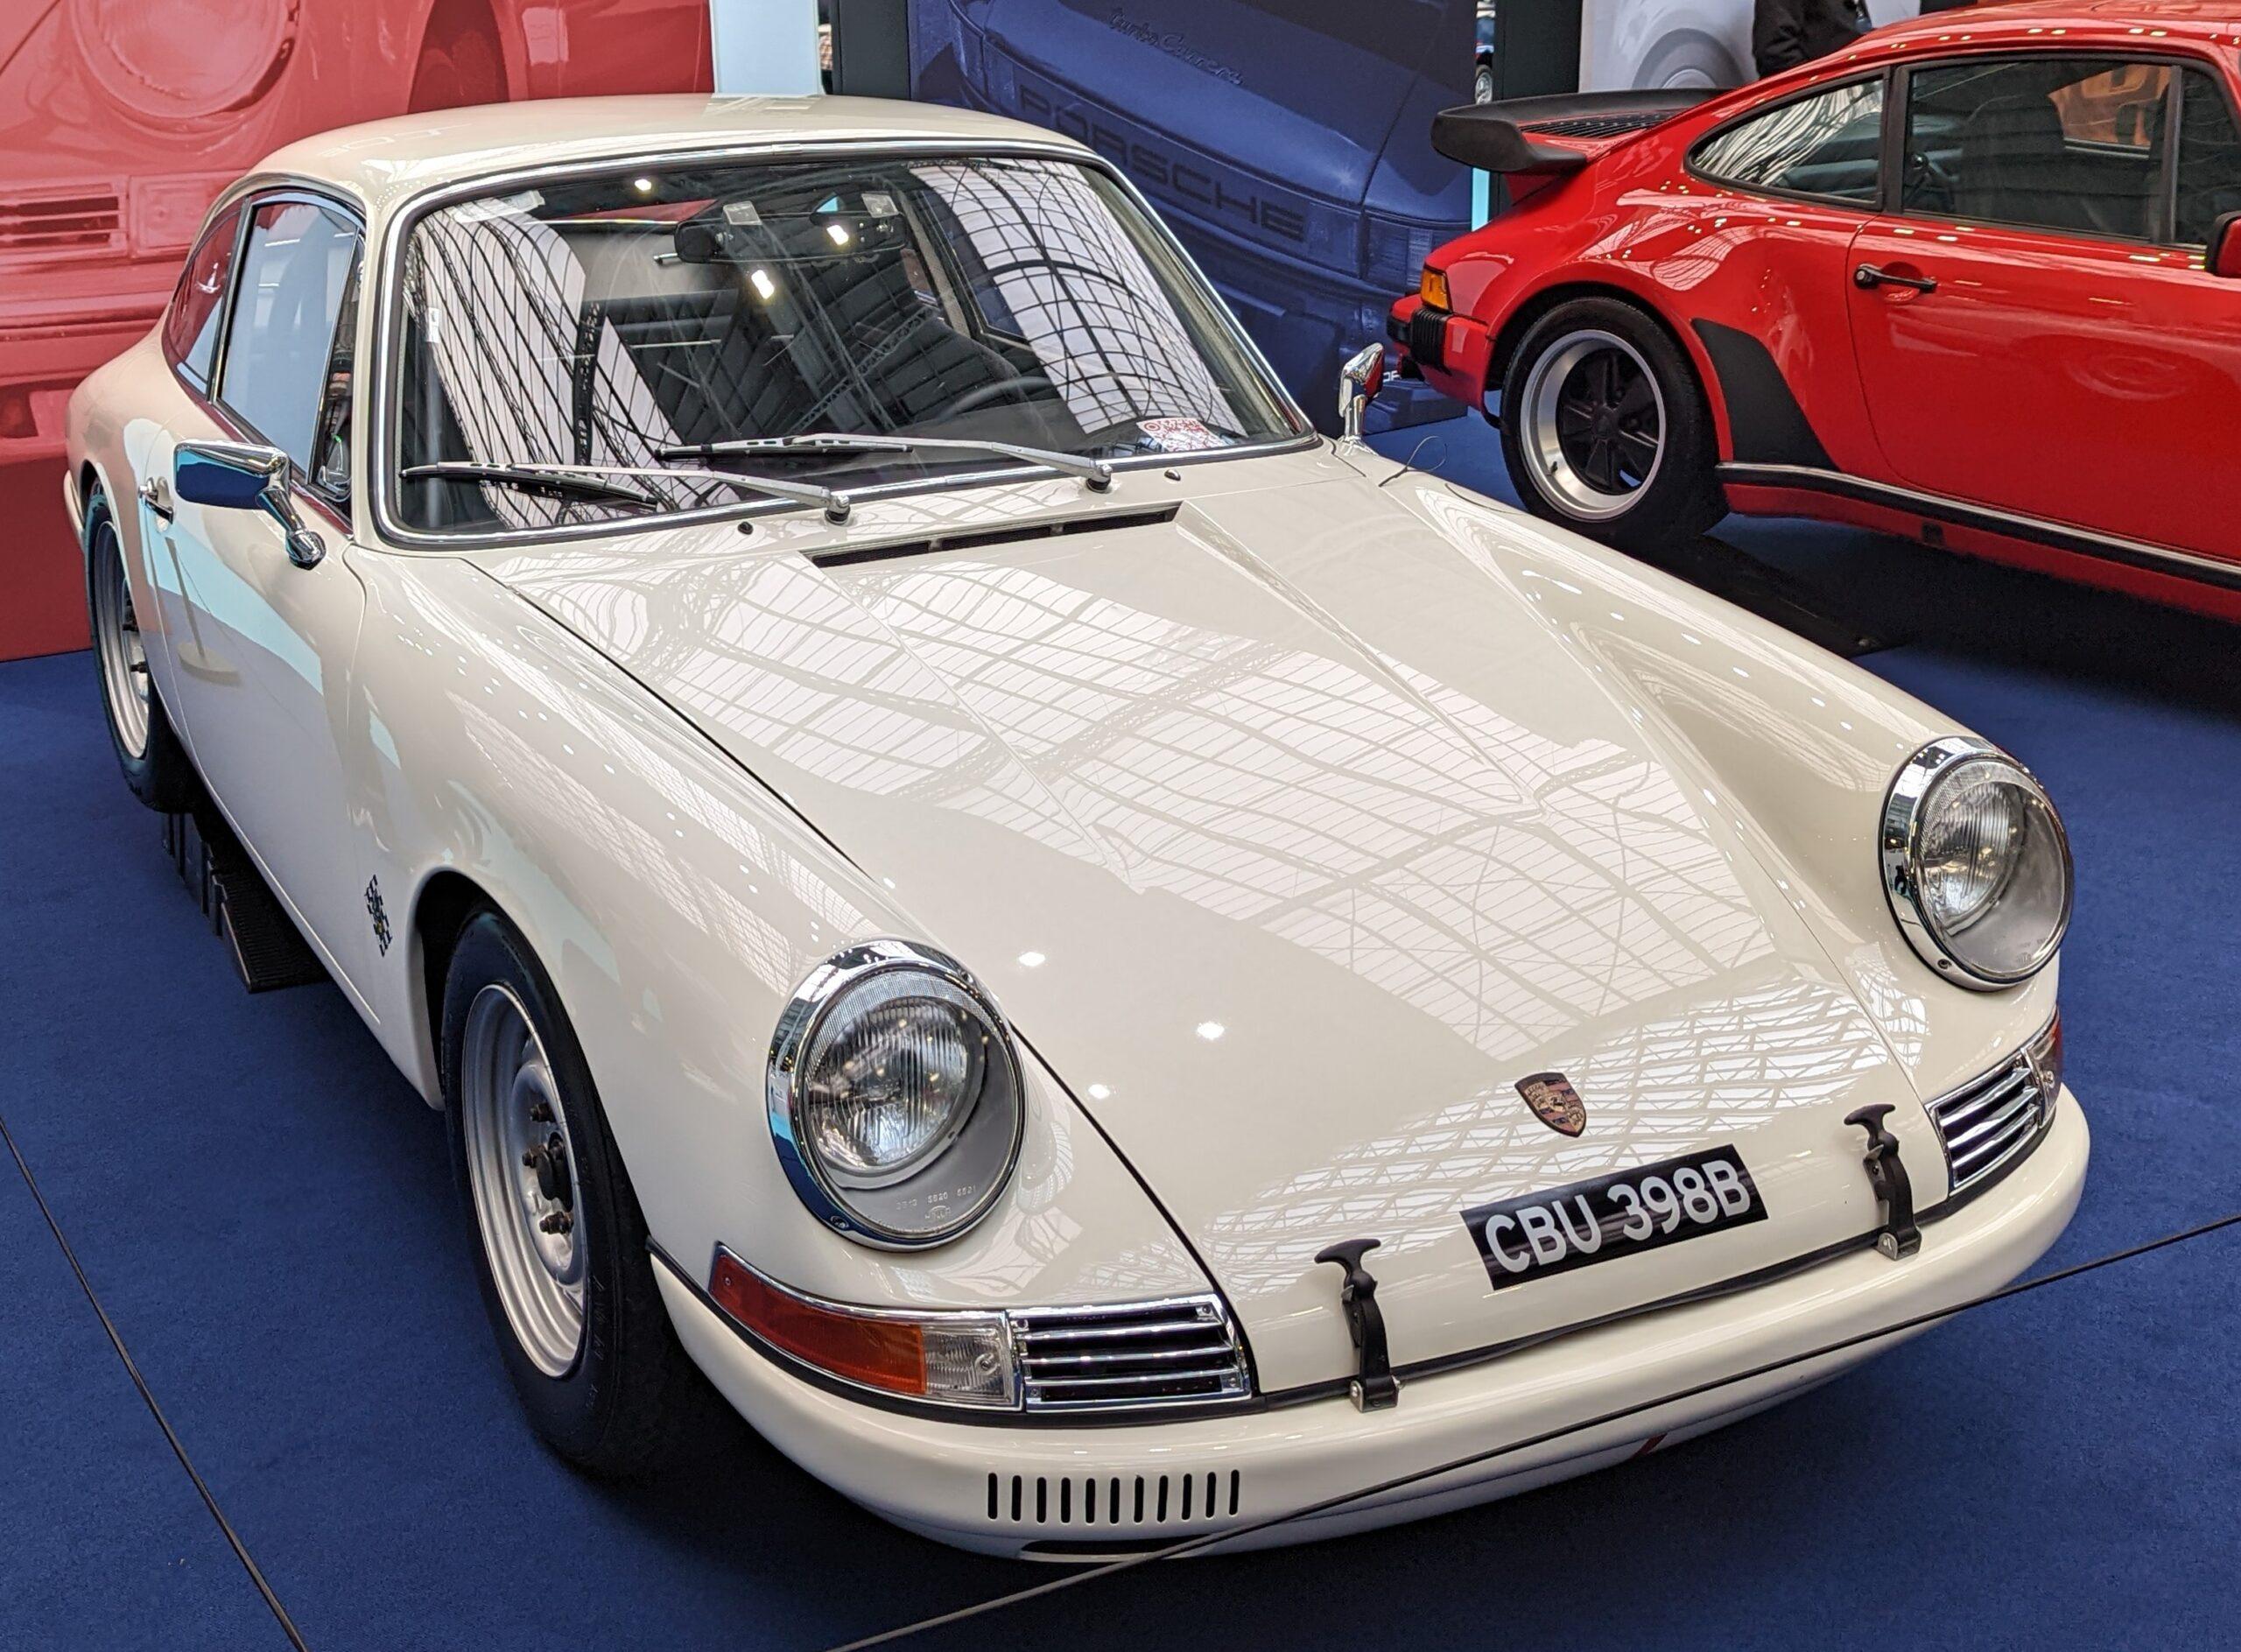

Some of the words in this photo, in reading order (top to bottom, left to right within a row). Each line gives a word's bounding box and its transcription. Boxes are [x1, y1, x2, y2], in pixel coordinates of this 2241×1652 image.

[1020, 85, 1305, 242] PORSCHE
[1486, 1195, 1602, 1273] CBU
[1607, 1160, 1751, 1241] 398B
